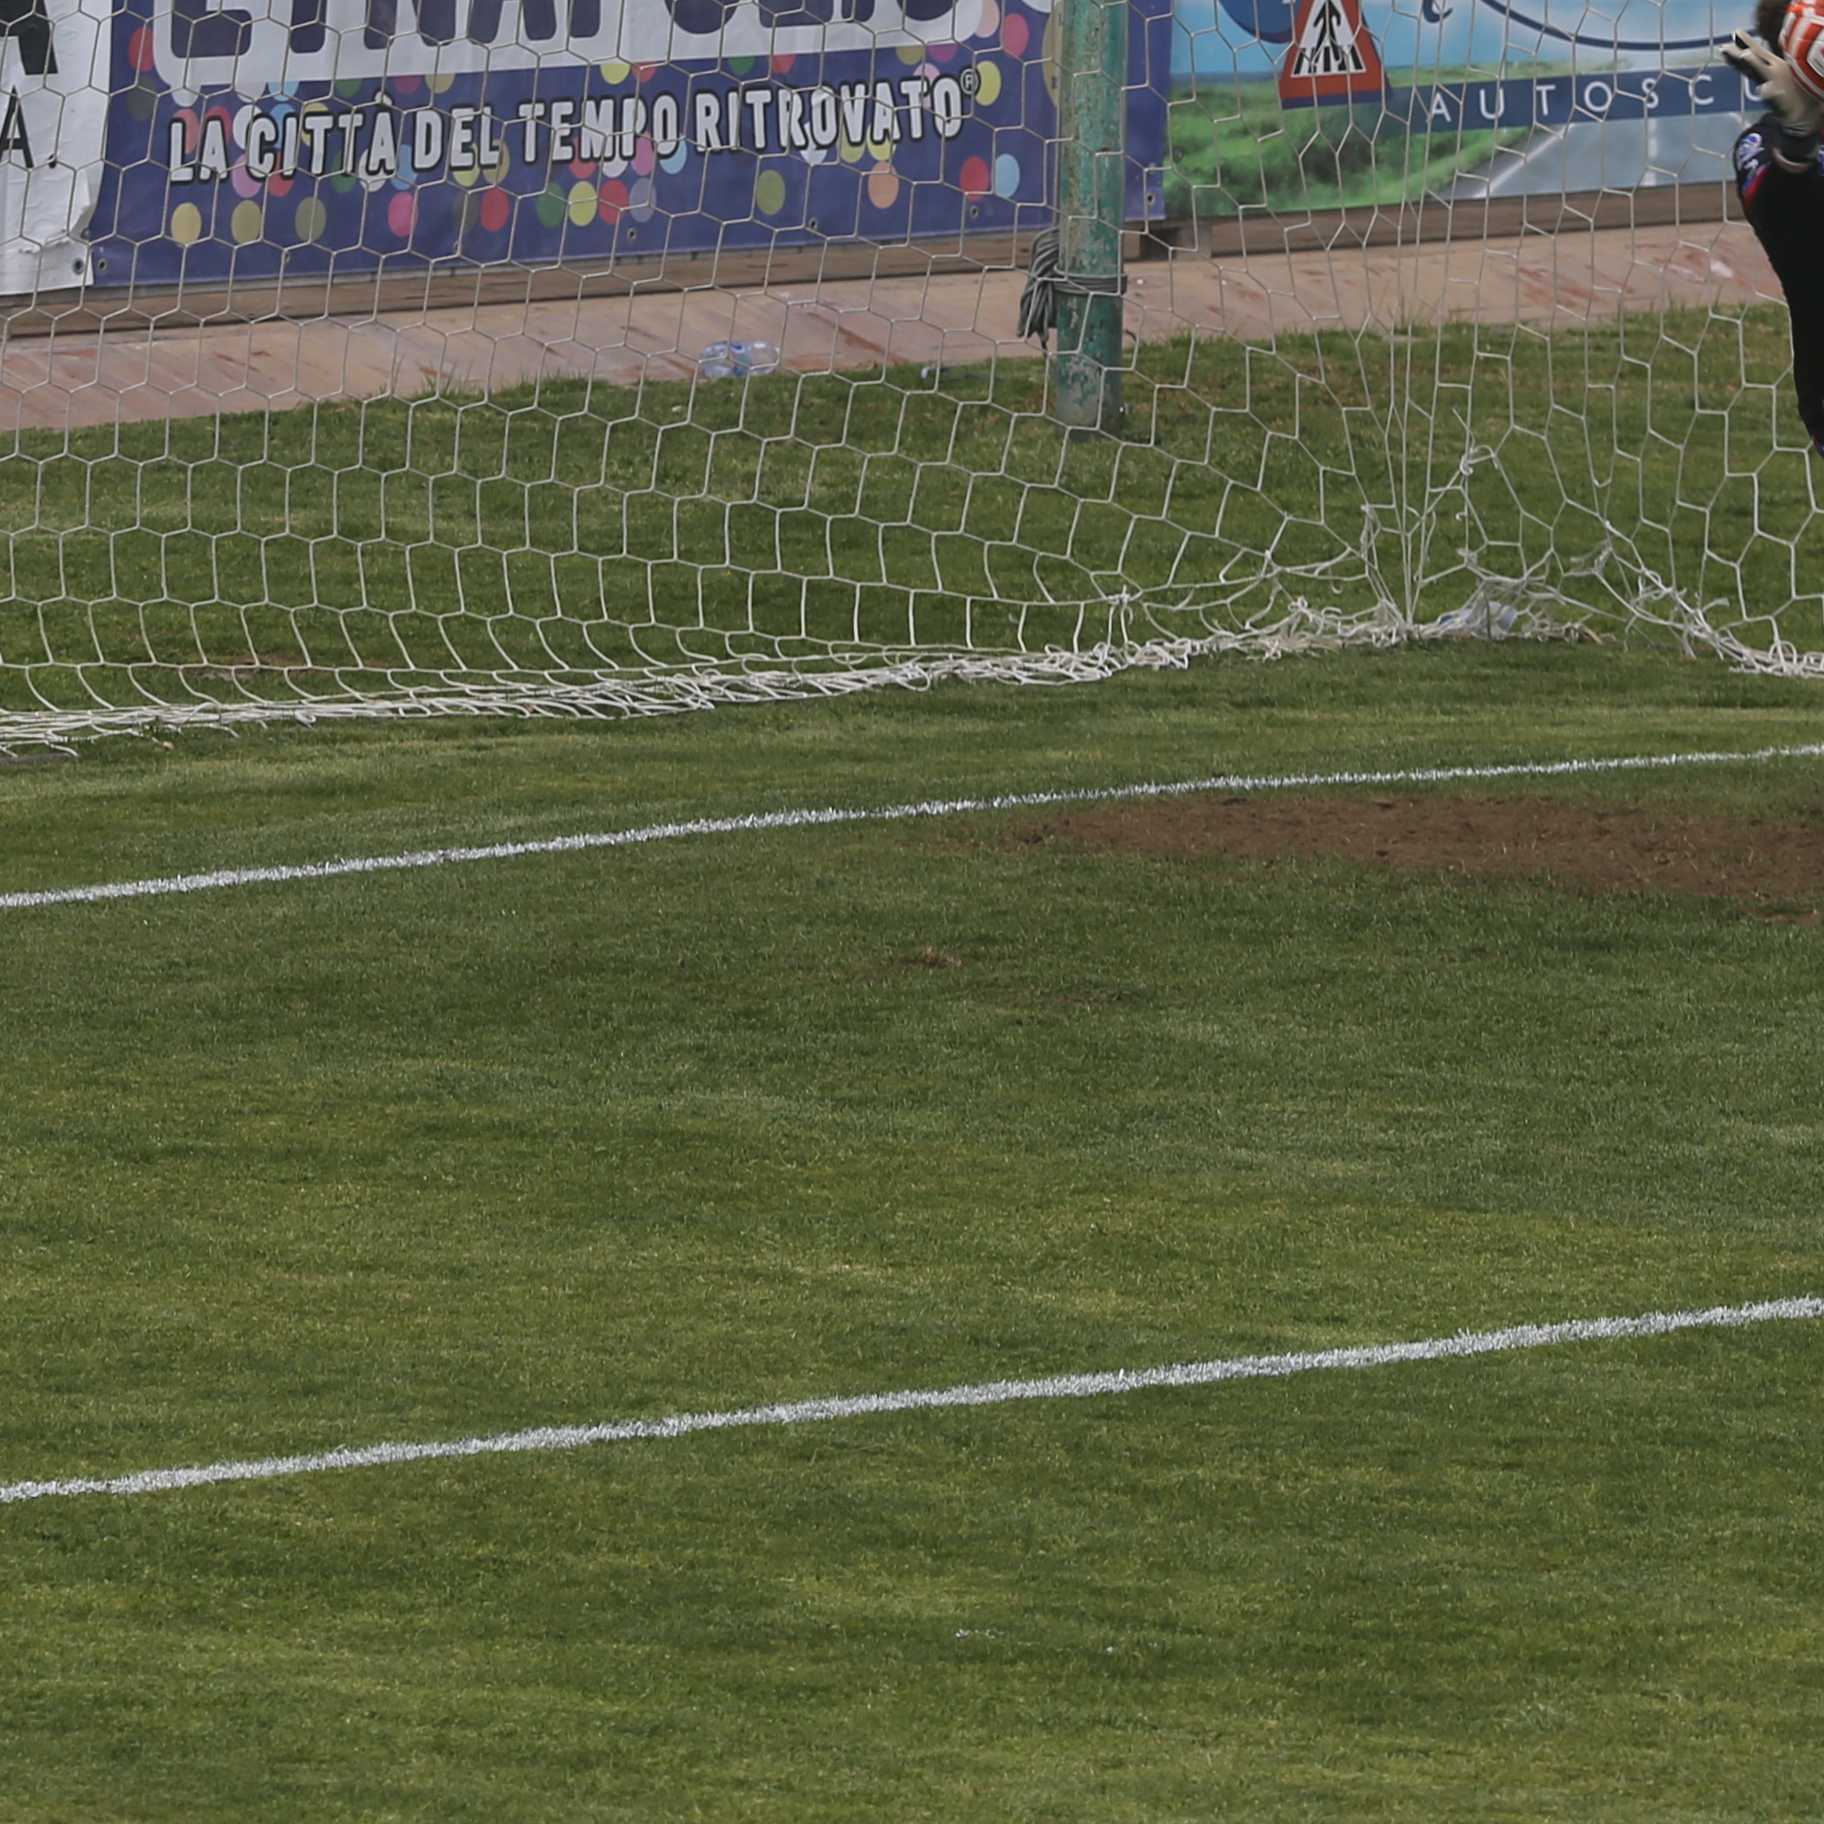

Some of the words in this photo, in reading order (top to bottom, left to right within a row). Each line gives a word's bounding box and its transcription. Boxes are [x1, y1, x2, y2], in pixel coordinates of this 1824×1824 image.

[168, 115, 227, 184] LA
[245, 93, 397, 179] CITTÀ
[411, 106, 501, 173] DEL
[517, 94, 679, 164] TEMPO
